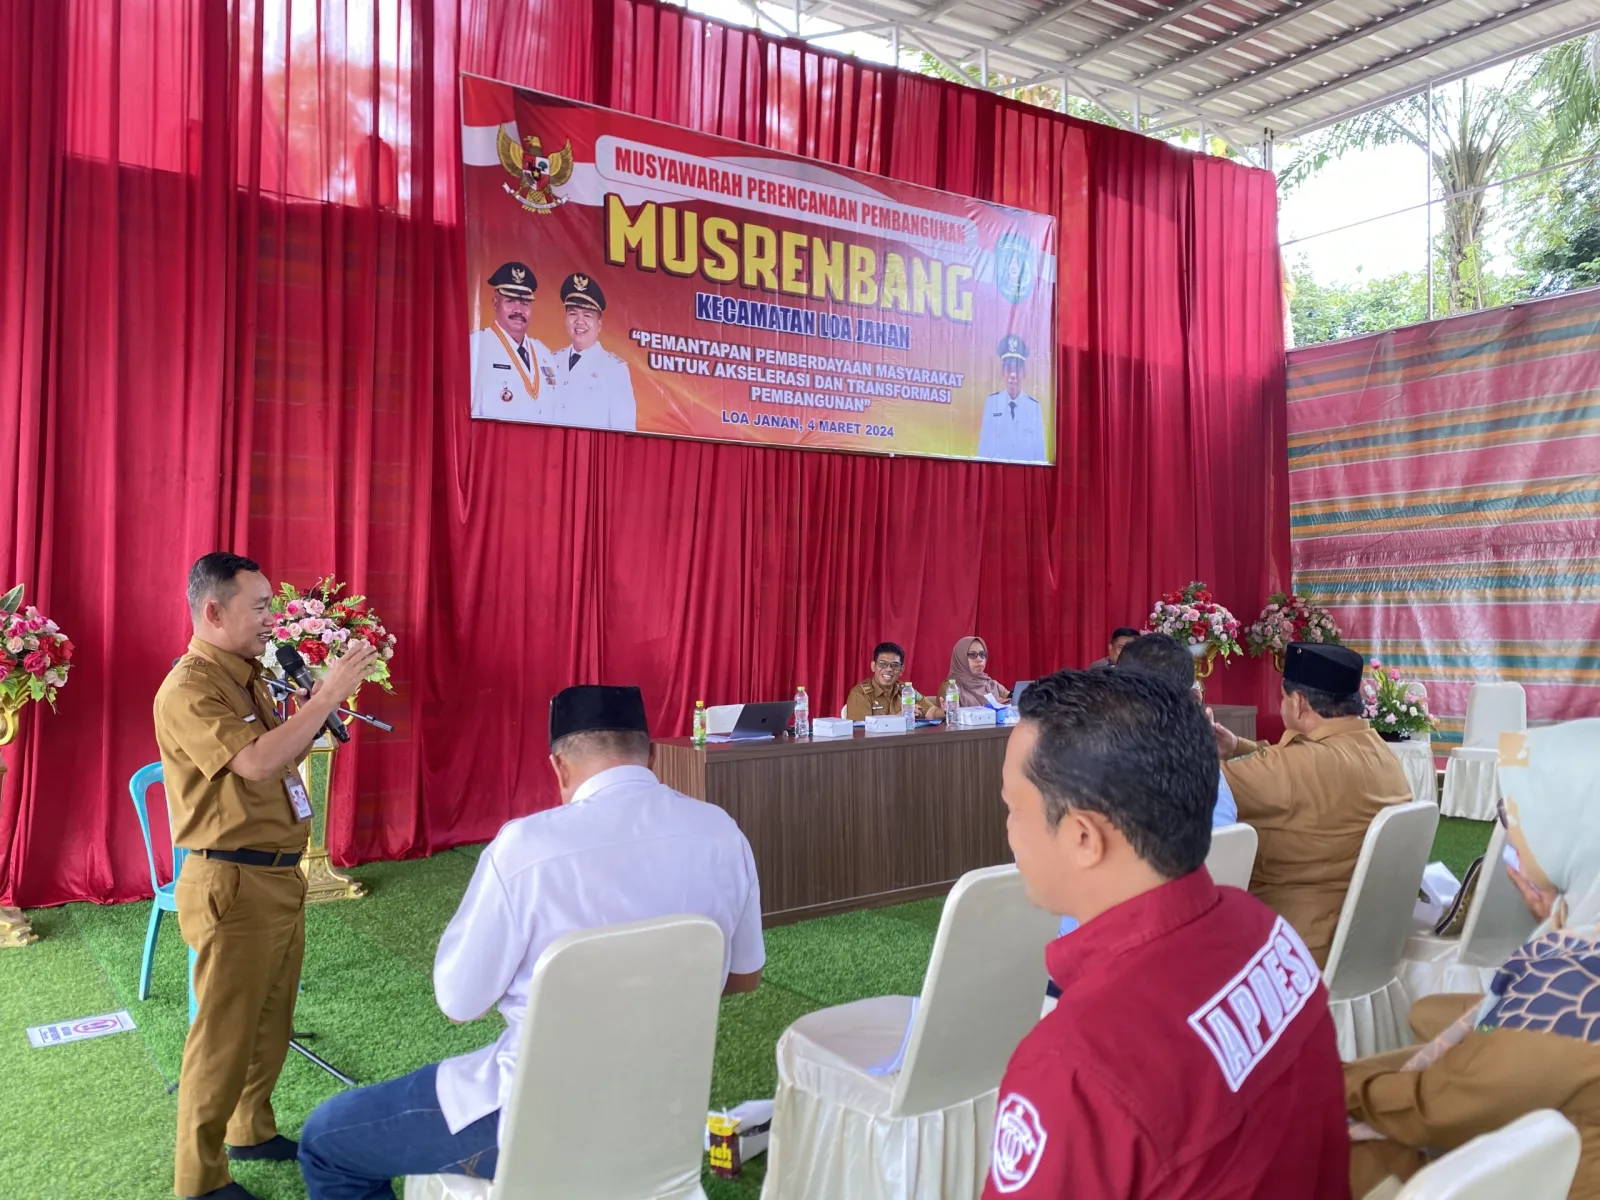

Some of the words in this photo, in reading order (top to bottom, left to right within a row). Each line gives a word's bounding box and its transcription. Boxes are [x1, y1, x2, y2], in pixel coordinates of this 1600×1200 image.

[614, 146, 743, 198] MUSYAWARAH
[747, 176, 858, 223] PERENCANAAN
[861, 203, 967, 245] PEMBANGUNAN
[605, 192, 974, 324] MUSRENBANG
[695, 291, 816, 336] KECAMATAN
[819, 311, 853, 342] LOA
[650, 353, 711, 376] UNTUK
[714, 362, 811, 388] AKSELERASI
[814, 374, 844, 392] DAN
[846, 378, 952, 404] TRANSFORMASI
[755, 347, 872, 377] PEMBERDAYAAN
[875, 364, 965, 388] MASYARAKAT
[721, 410, 750, 425] LOA
[753, 413, 804, 432] JANAN,
[806, 418, 816, 432] 4
[818, 420, 862, 435] MARET
[865, 423, 895, 438] 2024
